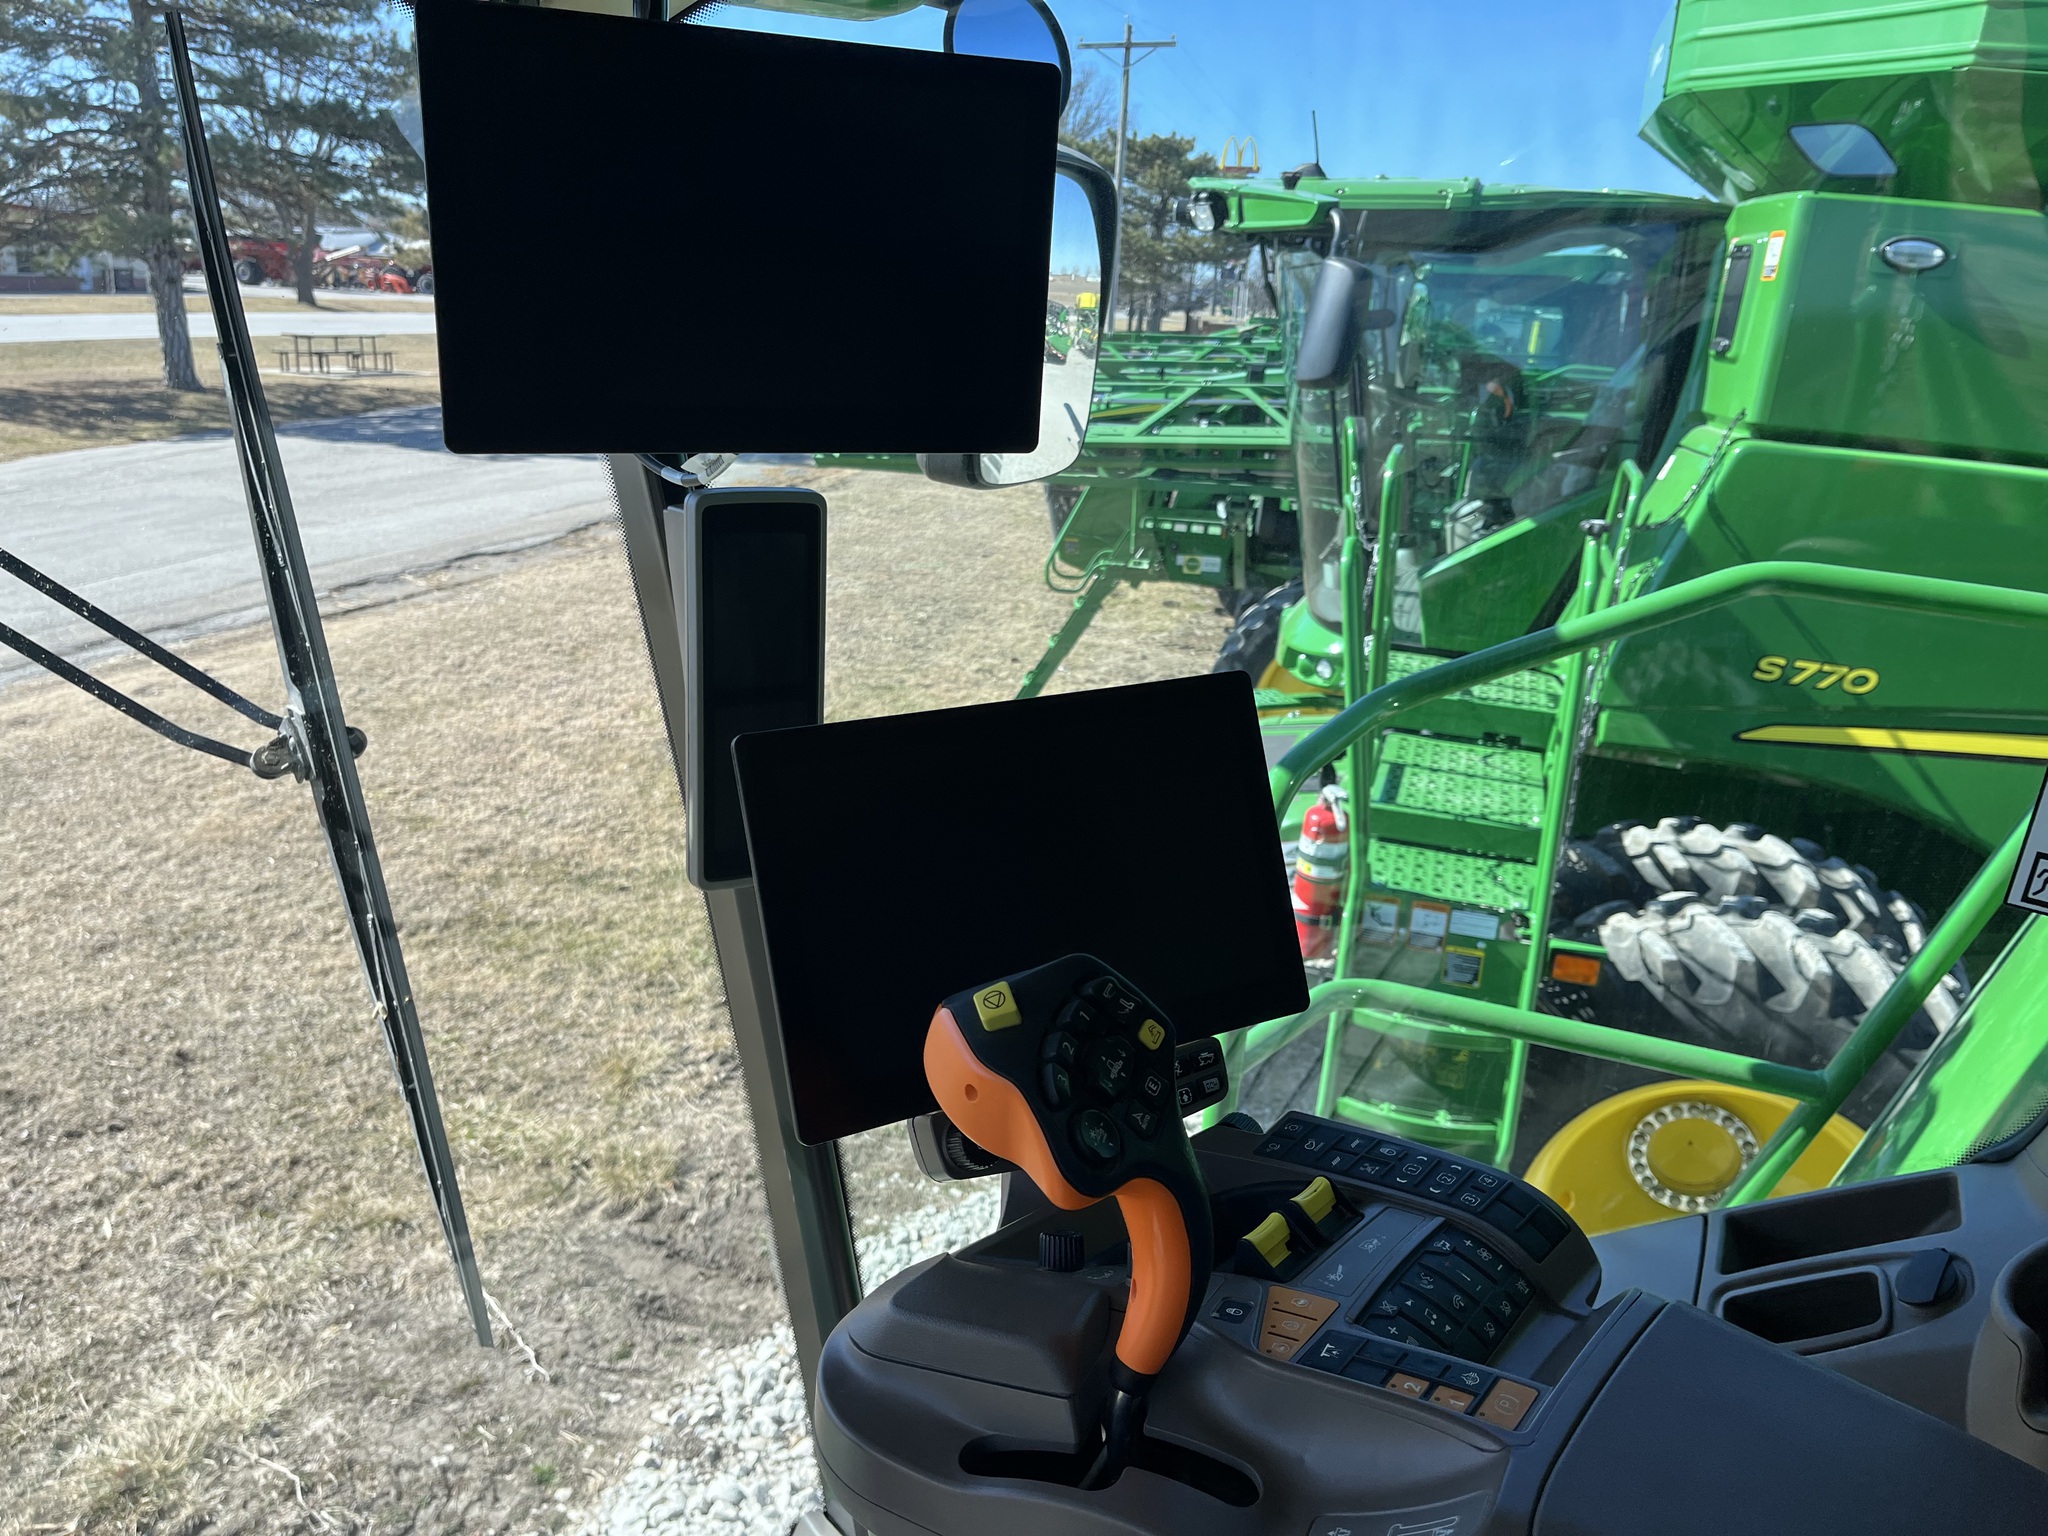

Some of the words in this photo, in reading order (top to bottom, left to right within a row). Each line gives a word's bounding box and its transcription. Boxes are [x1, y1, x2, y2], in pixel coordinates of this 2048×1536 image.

[1079, 1010, 1090, 1022] 1
[1062, 1041, 1074, 1055] 2
[1057, 1074, 1068, 1086] 3
[1404, 1382, 1421, 1393] 2
[1449, 1398, 1465, 1406] 1
